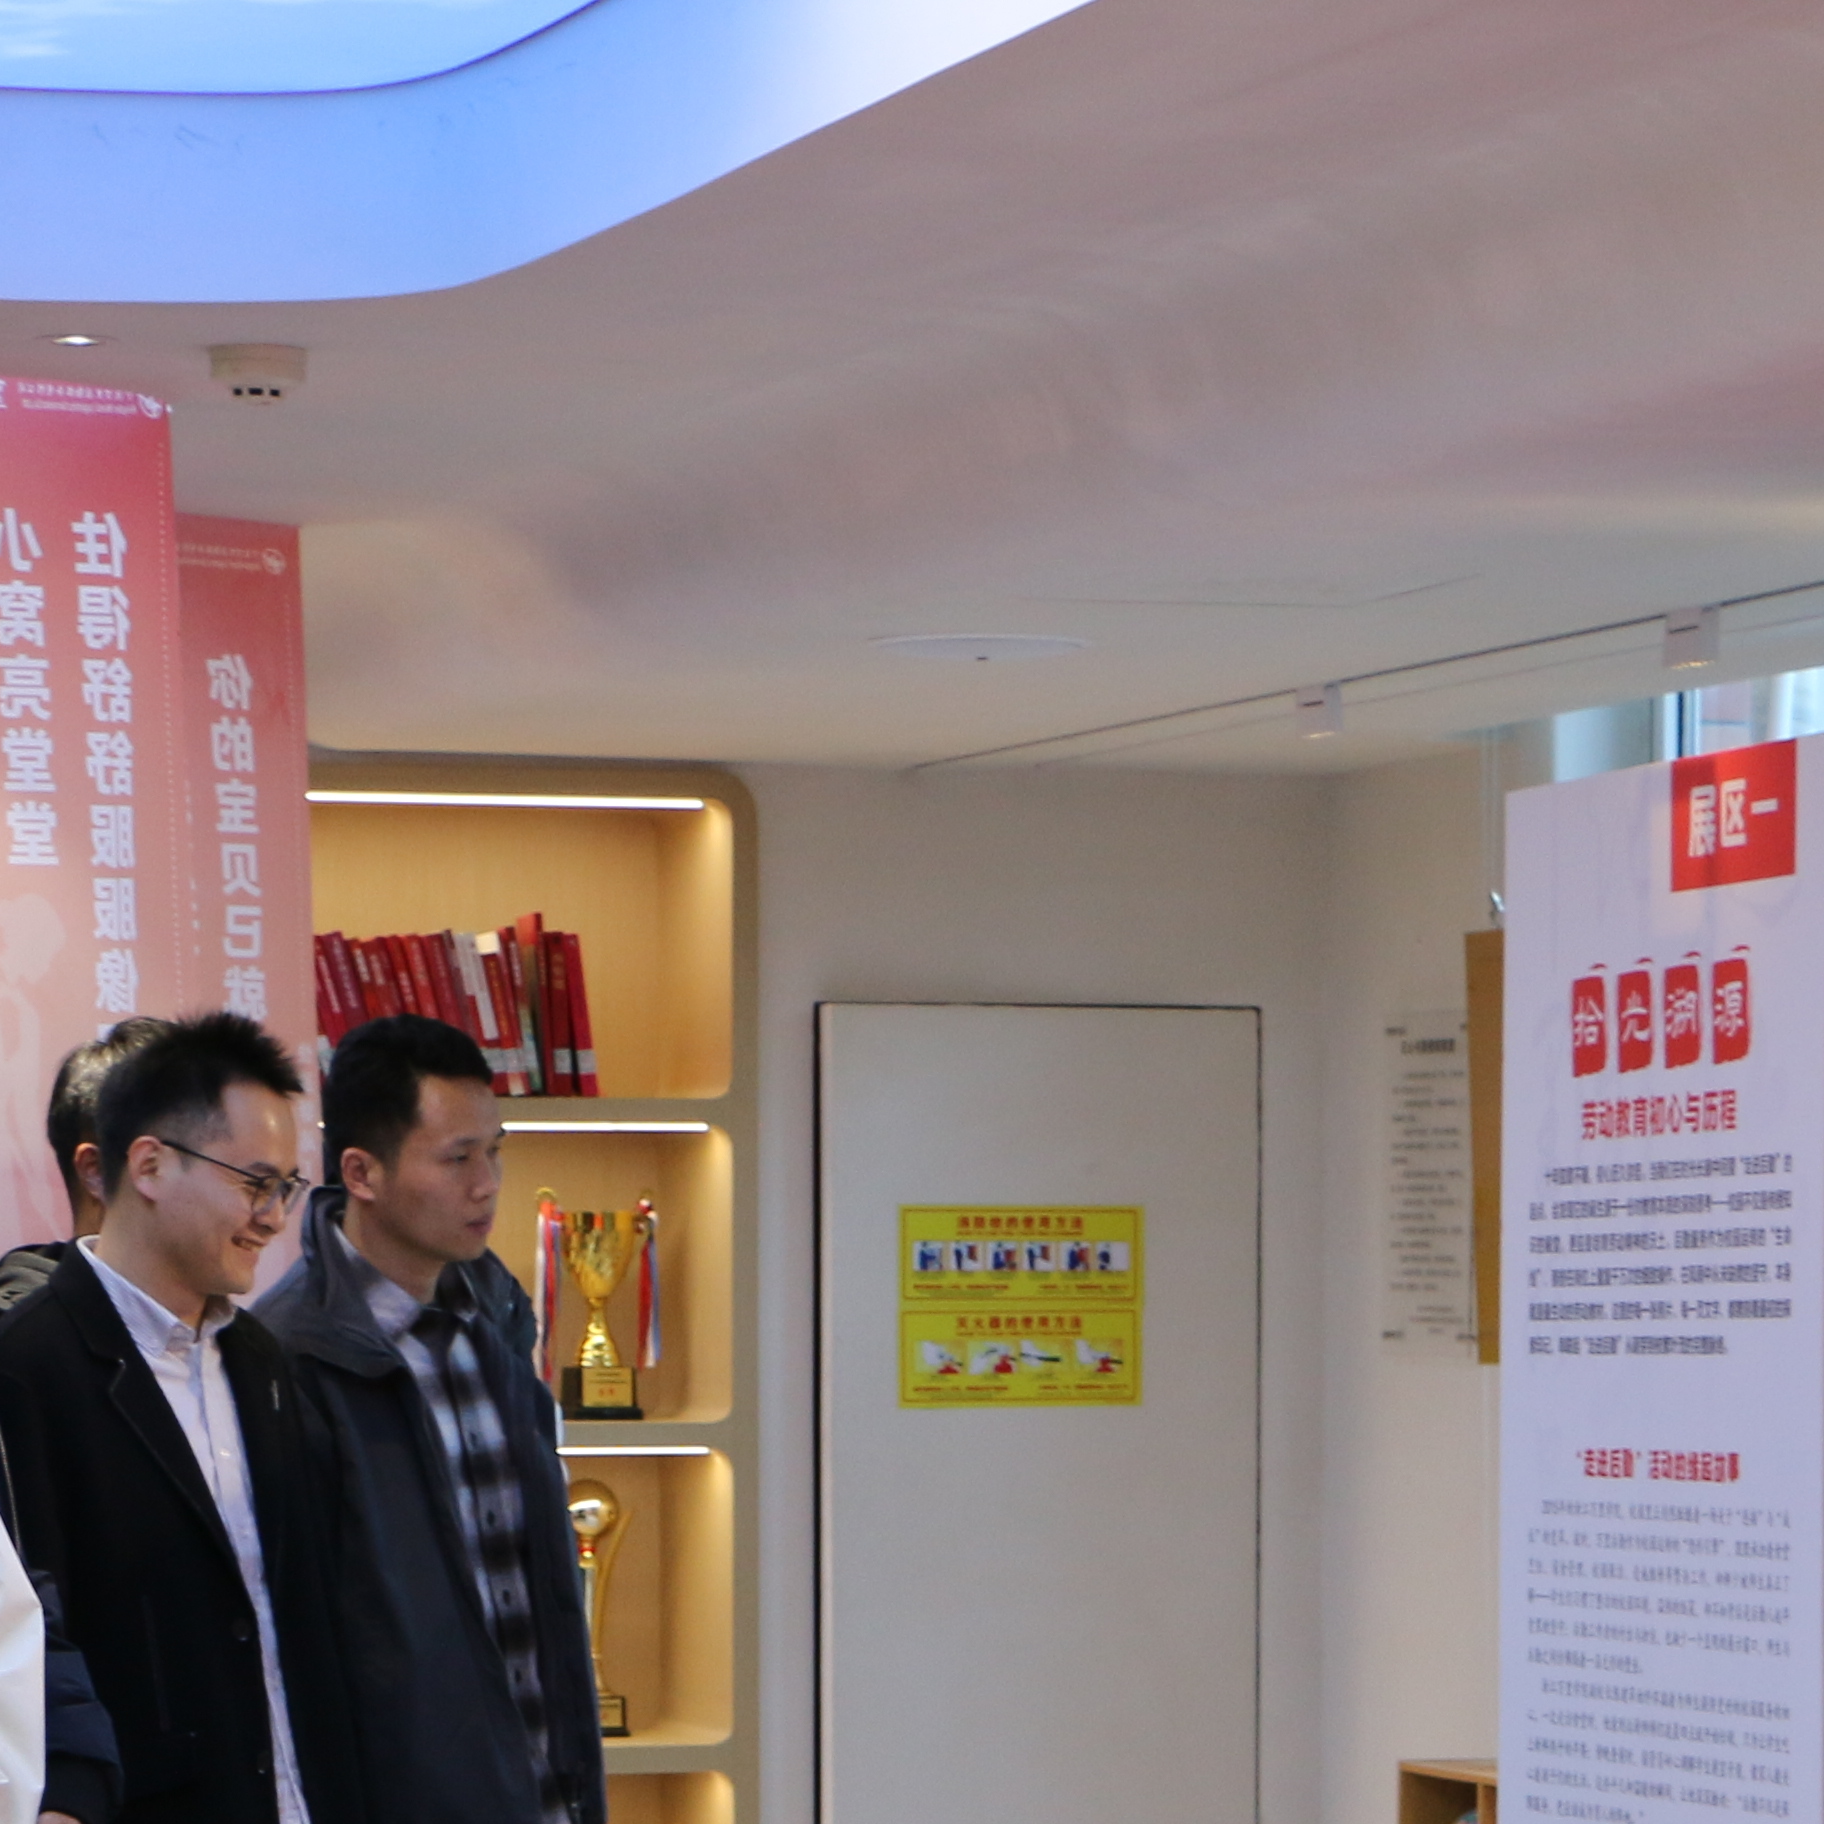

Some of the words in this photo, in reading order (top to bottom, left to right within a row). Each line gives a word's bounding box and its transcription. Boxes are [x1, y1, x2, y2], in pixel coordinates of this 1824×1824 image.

[1688, 777, 1778, 858] 展区一
[1574, 980, 1749, 1048] 拾光溯源
[1581, 1089, 1738, 1140] 劳动教育初心与历程
